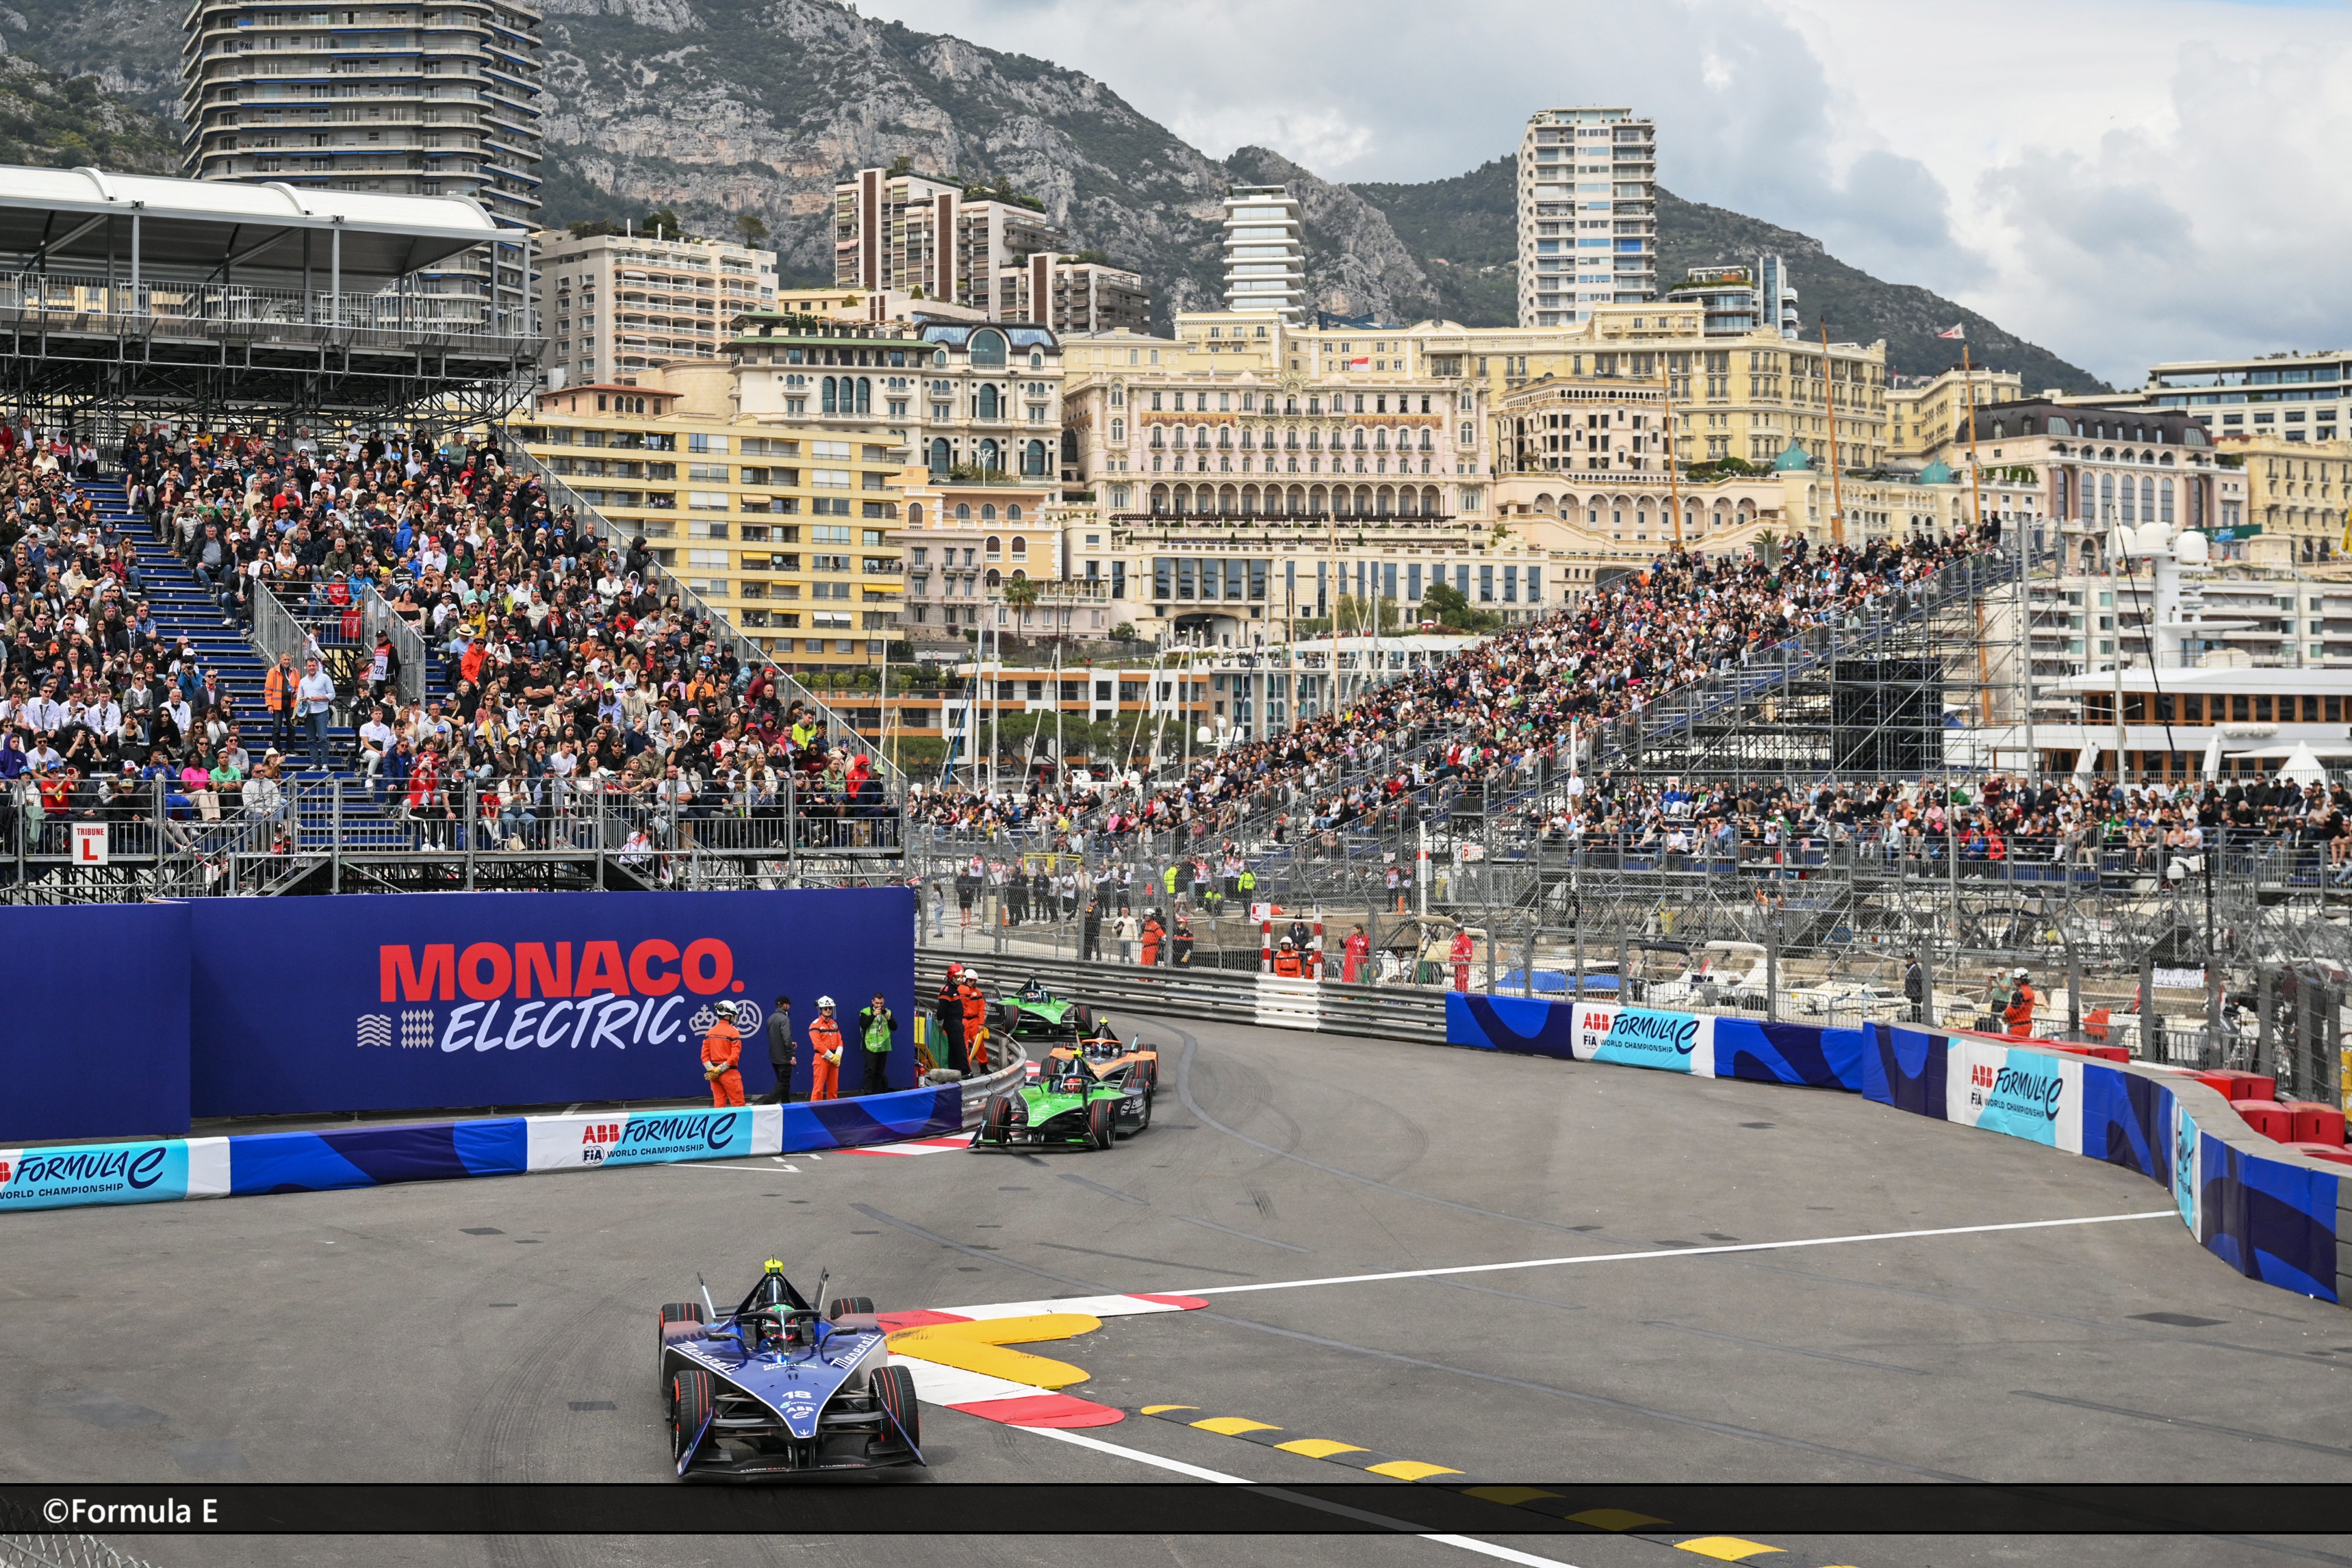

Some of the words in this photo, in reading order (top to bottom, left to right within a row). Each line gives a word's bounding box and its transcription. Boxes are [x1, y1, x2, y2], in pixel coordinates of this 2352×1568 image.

[374, 665, 385, 676] 272
[77, 827, 105, 836] TRIBUNE
[83, 838, 98, 860] L
[380, 938, 745, 1002] MONACO.
[441, 992, 686, 1053] ELECTRIC.
[1583, 1012, 1610, 1031] ABB
[1611, 1014, 1678, 1042] FORMULA
[1600, 1039, 1622, 1048] WORLD
[1624, 1042, 1673, 1053] CHAMPIONSHIP
[1971, 1064, 1993, 1088] ABB
[1993, 1067, 2048, 1103] FORMULA
[1984, 1098, 2005, 1109] WORLD
[2006, 1103, 2045, 1118] CHAMPIONSHIP
[582, 1123, 620, 1144] ABB
[622, 1115, 710, 1144] FORMULA
[607, 1149, 637, 1157] WORLD
[641, 1144, 704, 1155] CHAMPIONSHIP
[14, 1151, 129, 1185] FORMULA
[38, 1183, 124, 1196] CHAMPIONSHIP
[673, 1340, 740, 1376] Maserati
[830, 1334, 882, 1369] Maserati
[782, 1390, 812, 1399] 18
